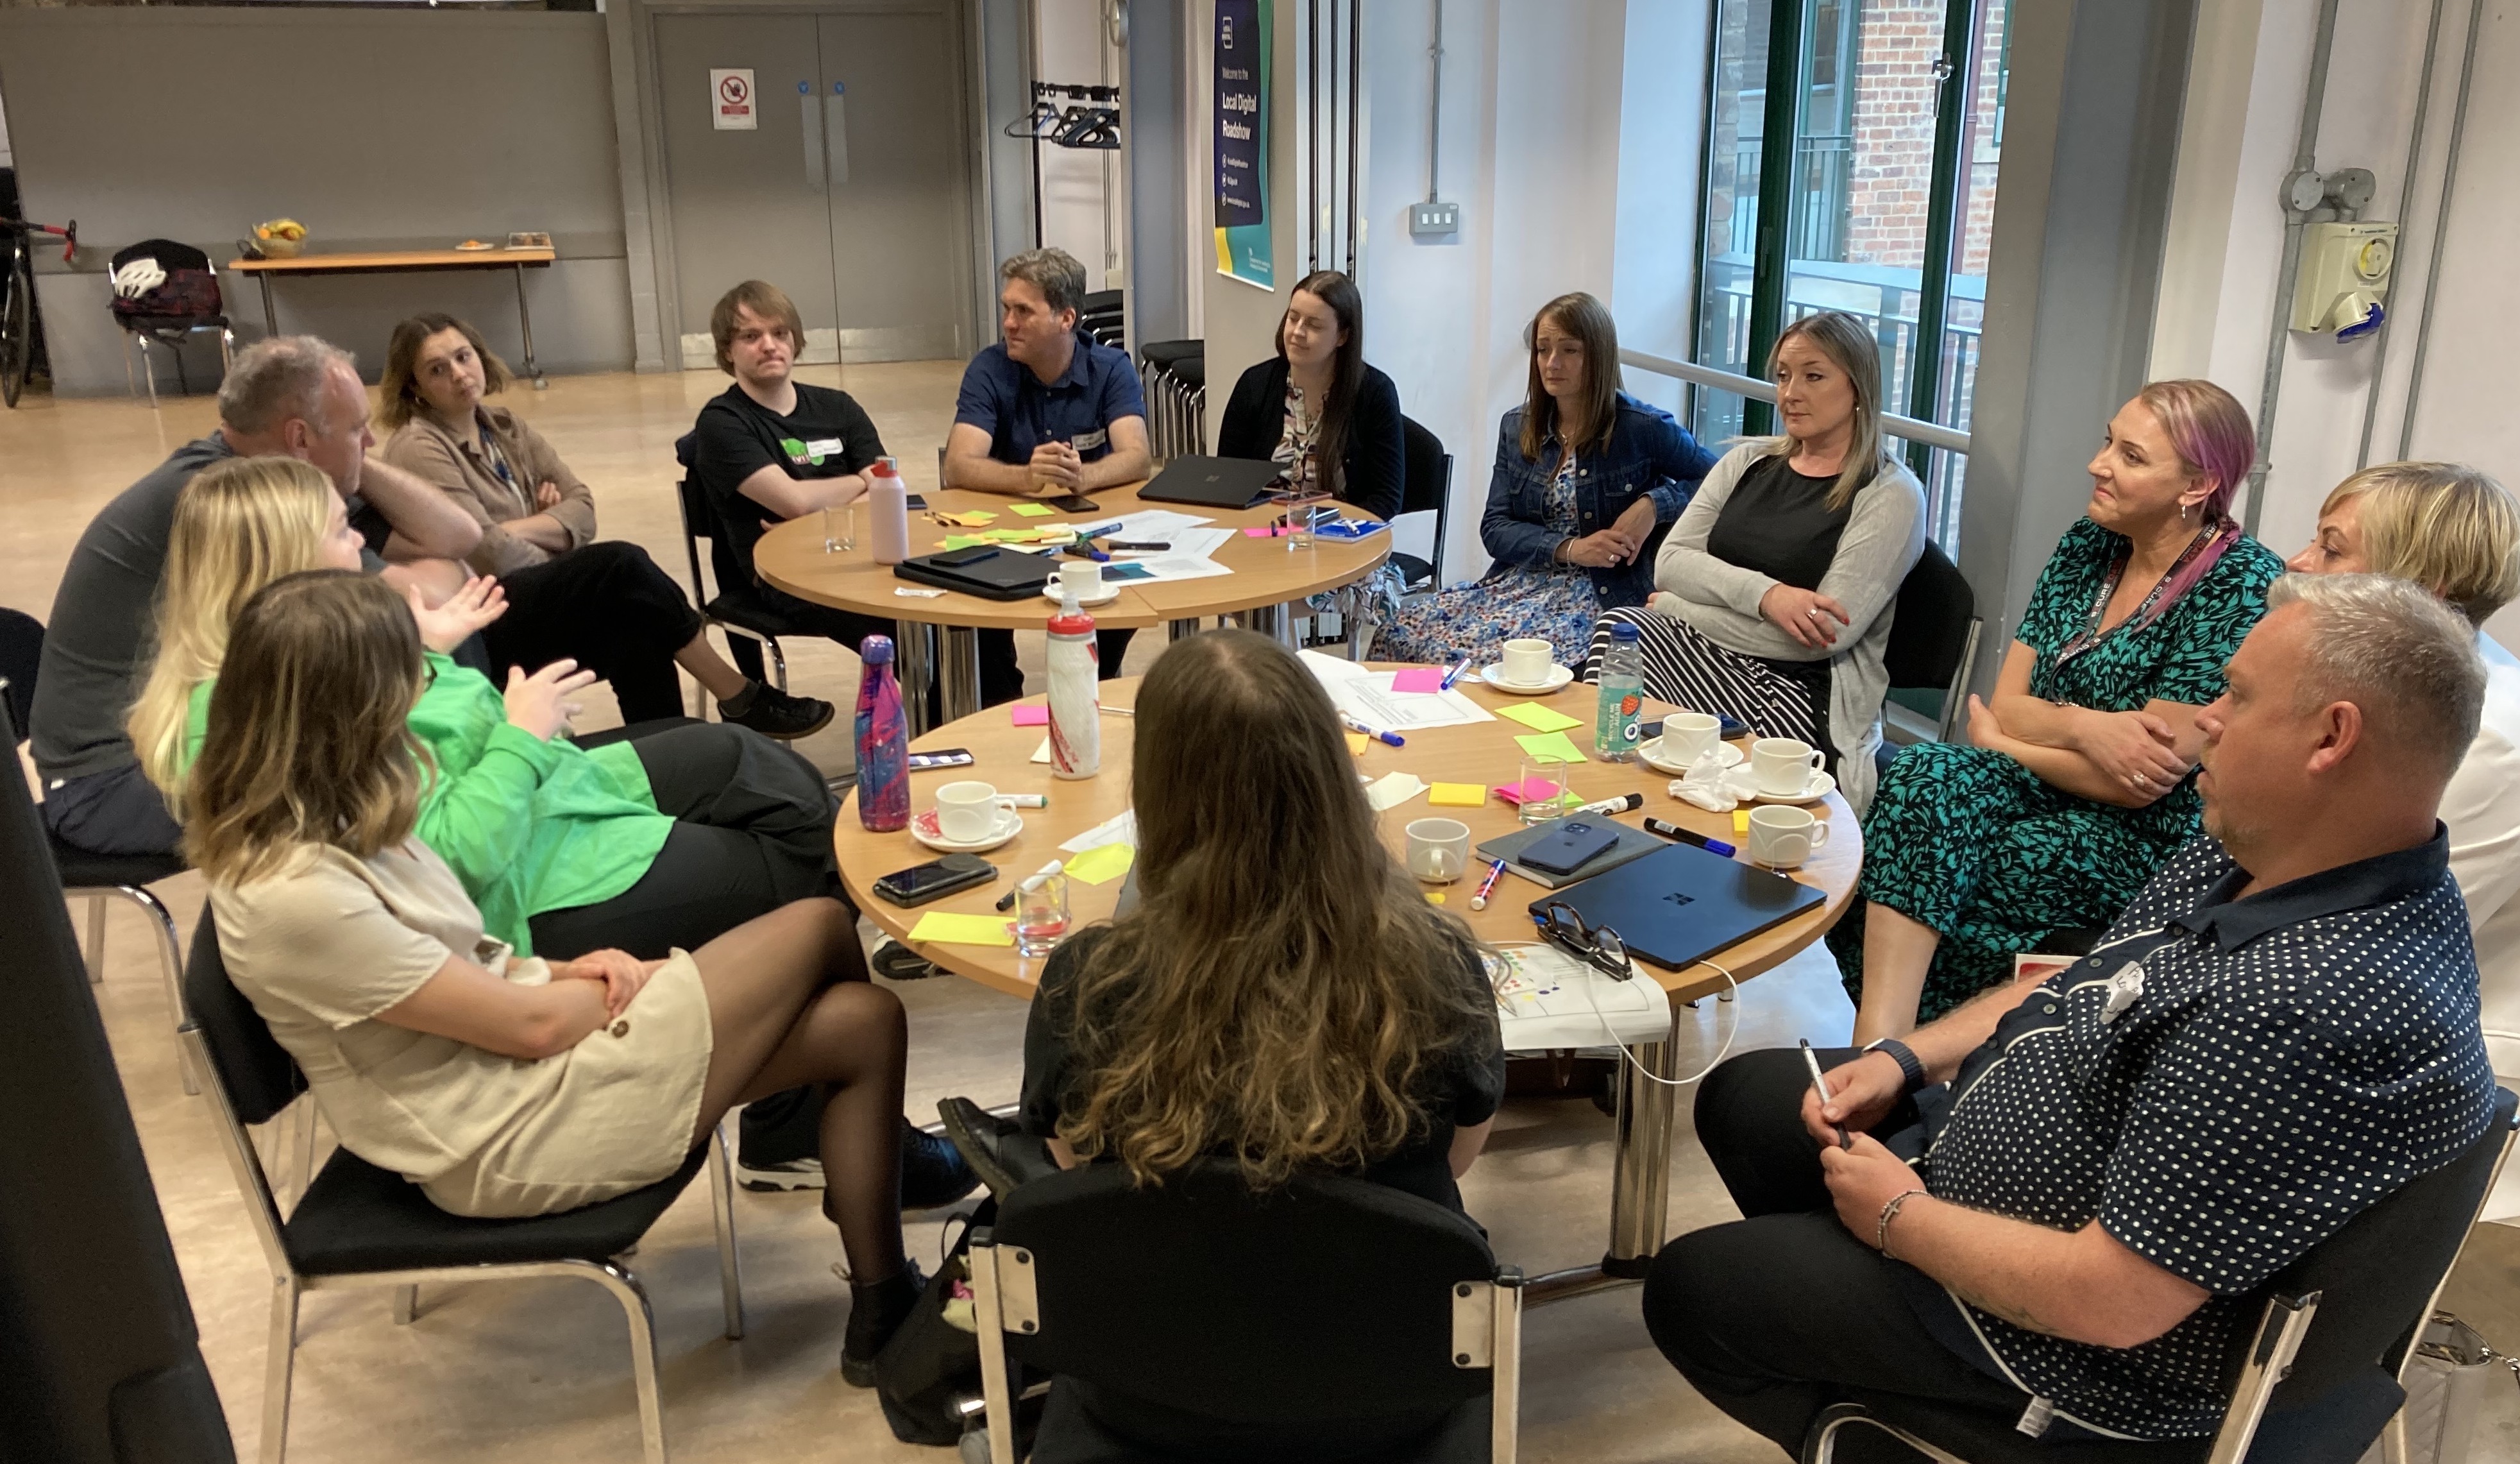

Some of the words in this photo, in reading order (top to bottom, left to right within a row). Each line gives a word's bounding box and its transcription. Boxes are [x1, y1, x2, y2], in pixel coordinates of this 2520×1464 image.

[1222, 91, 1238, 110] Local
[1238, 93, 1257, 115] Digital
[1222, 119, 1251, 140] Roadshow
[1609, 702, 1615, 713] ME
